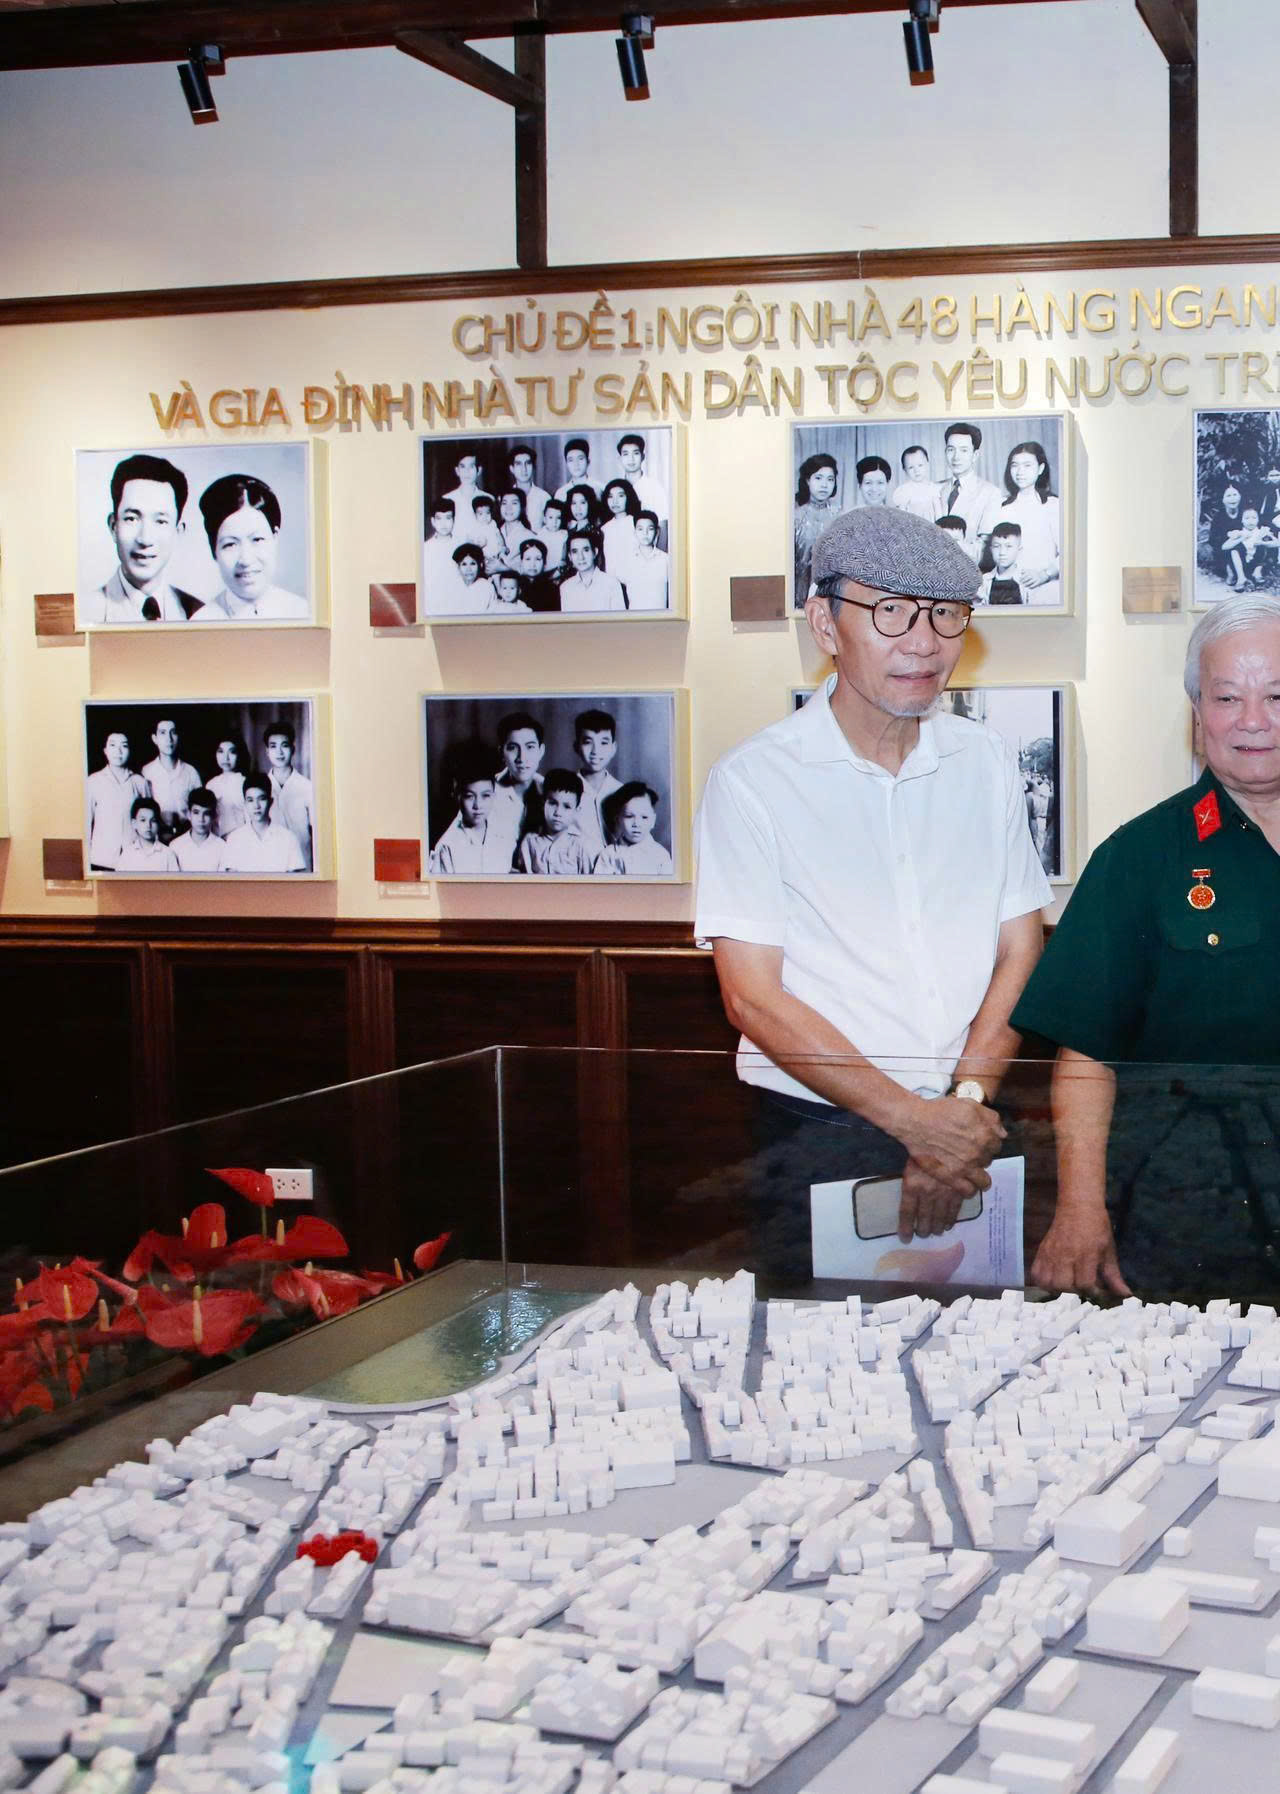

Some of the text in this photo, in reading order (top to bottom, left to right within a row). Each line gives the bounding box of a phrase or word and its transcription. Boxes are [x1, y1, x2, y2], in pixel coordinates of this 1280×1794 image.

[452, 297, 546, 355] CHỦ
[656, 290, 779, 348] NGÔI
[790, 285, 893, 343] NHÀ
[897, 295, 959, 337] 48
[970, 281, 1115, 336] HÀNG
[148, 380, 205, 430] VÀ
[208, 387, 289, 429] GIA
[300, 370, 412, 429] ĐÌNH
[422, 364, 517, 421] NHÀ
[514, 368, 585, 417] TƯ
[593, 360, 693, 416] SẢN
[704, 353, 803, 411] DÂN
[815, 351, 920, 413] TỘC
[932, 346, 1028, 401] YÊU
[1045, 338, 1191, 398] NƯỚC
